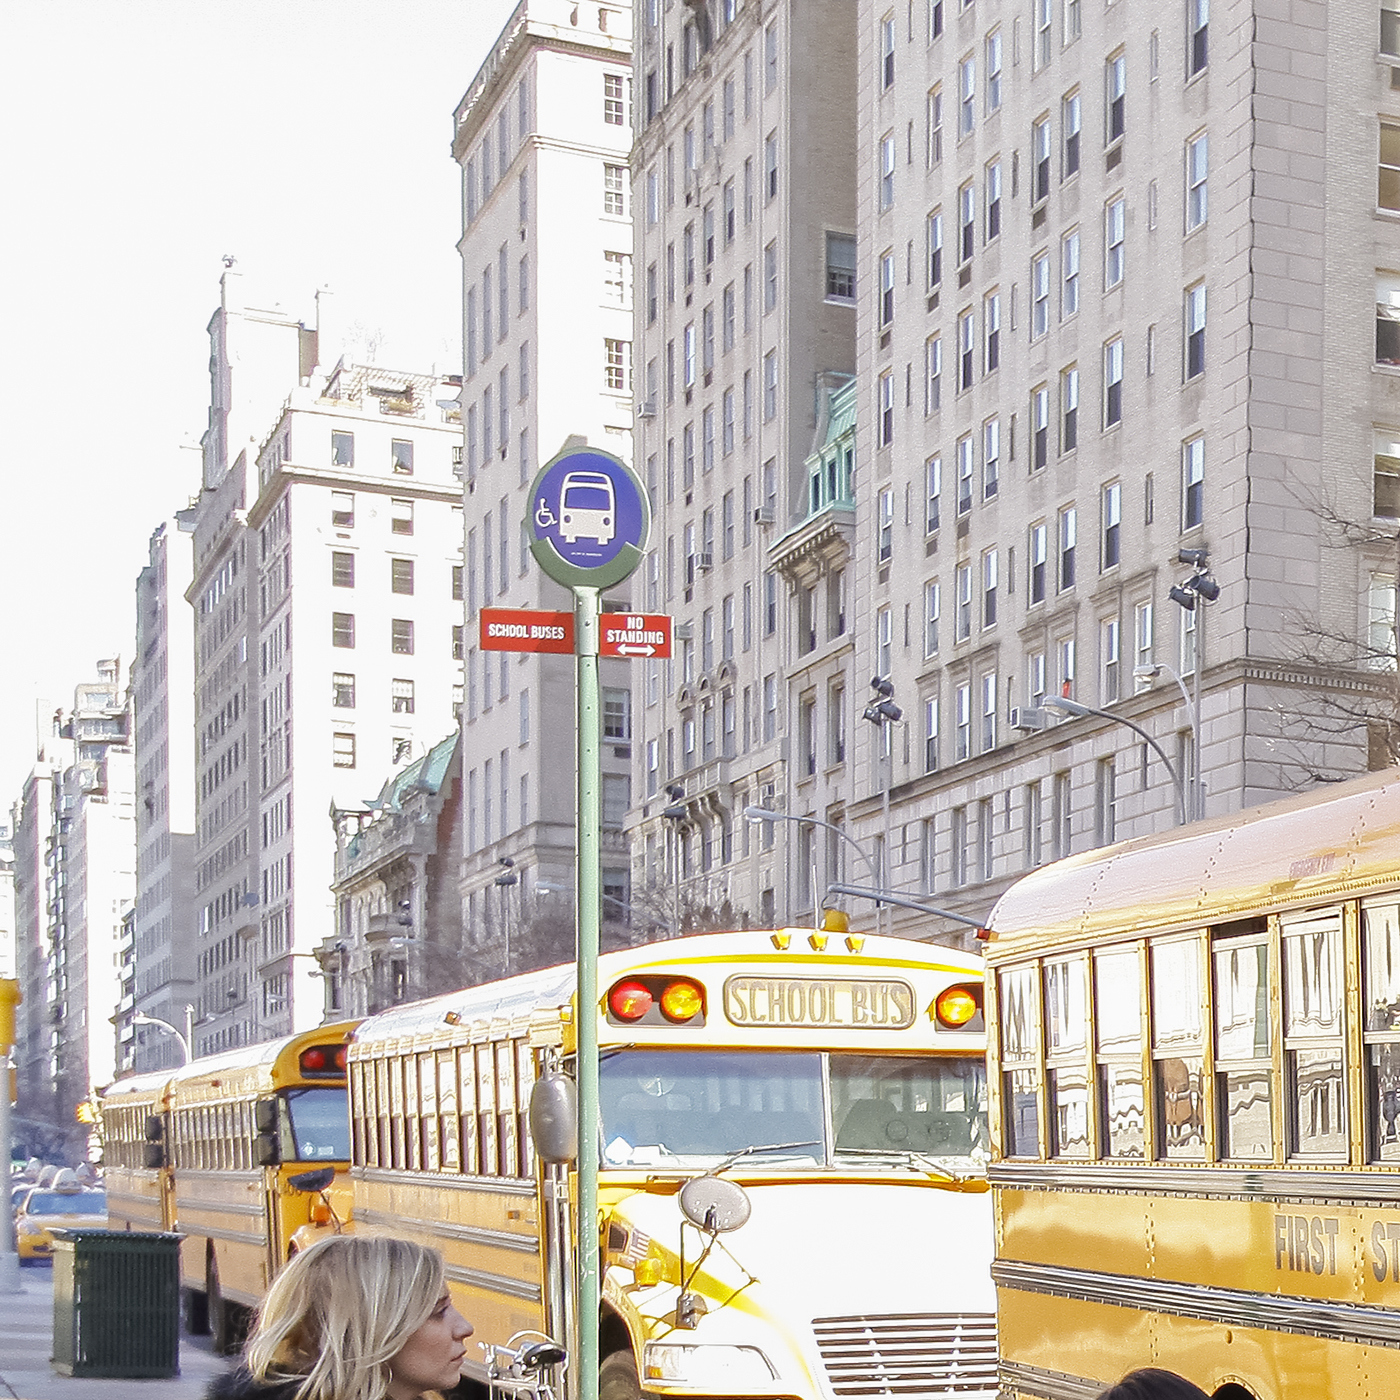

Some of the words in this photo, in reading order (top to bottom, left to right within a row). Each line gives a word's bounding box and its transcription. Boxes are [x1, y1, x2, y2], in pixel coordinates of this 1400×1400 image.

[627, 616, 644, 629] NO
[488, 623, 529, 638] SCHOOL
[531, 625, 565, 640] BUSES
[606, 629, 665, 644] STANDING
[730, 980, 843, 1024] SCHOOL
[851, 984, 911, 1025] BUS
[1274, 1215, 1339, 1276] FIRST
